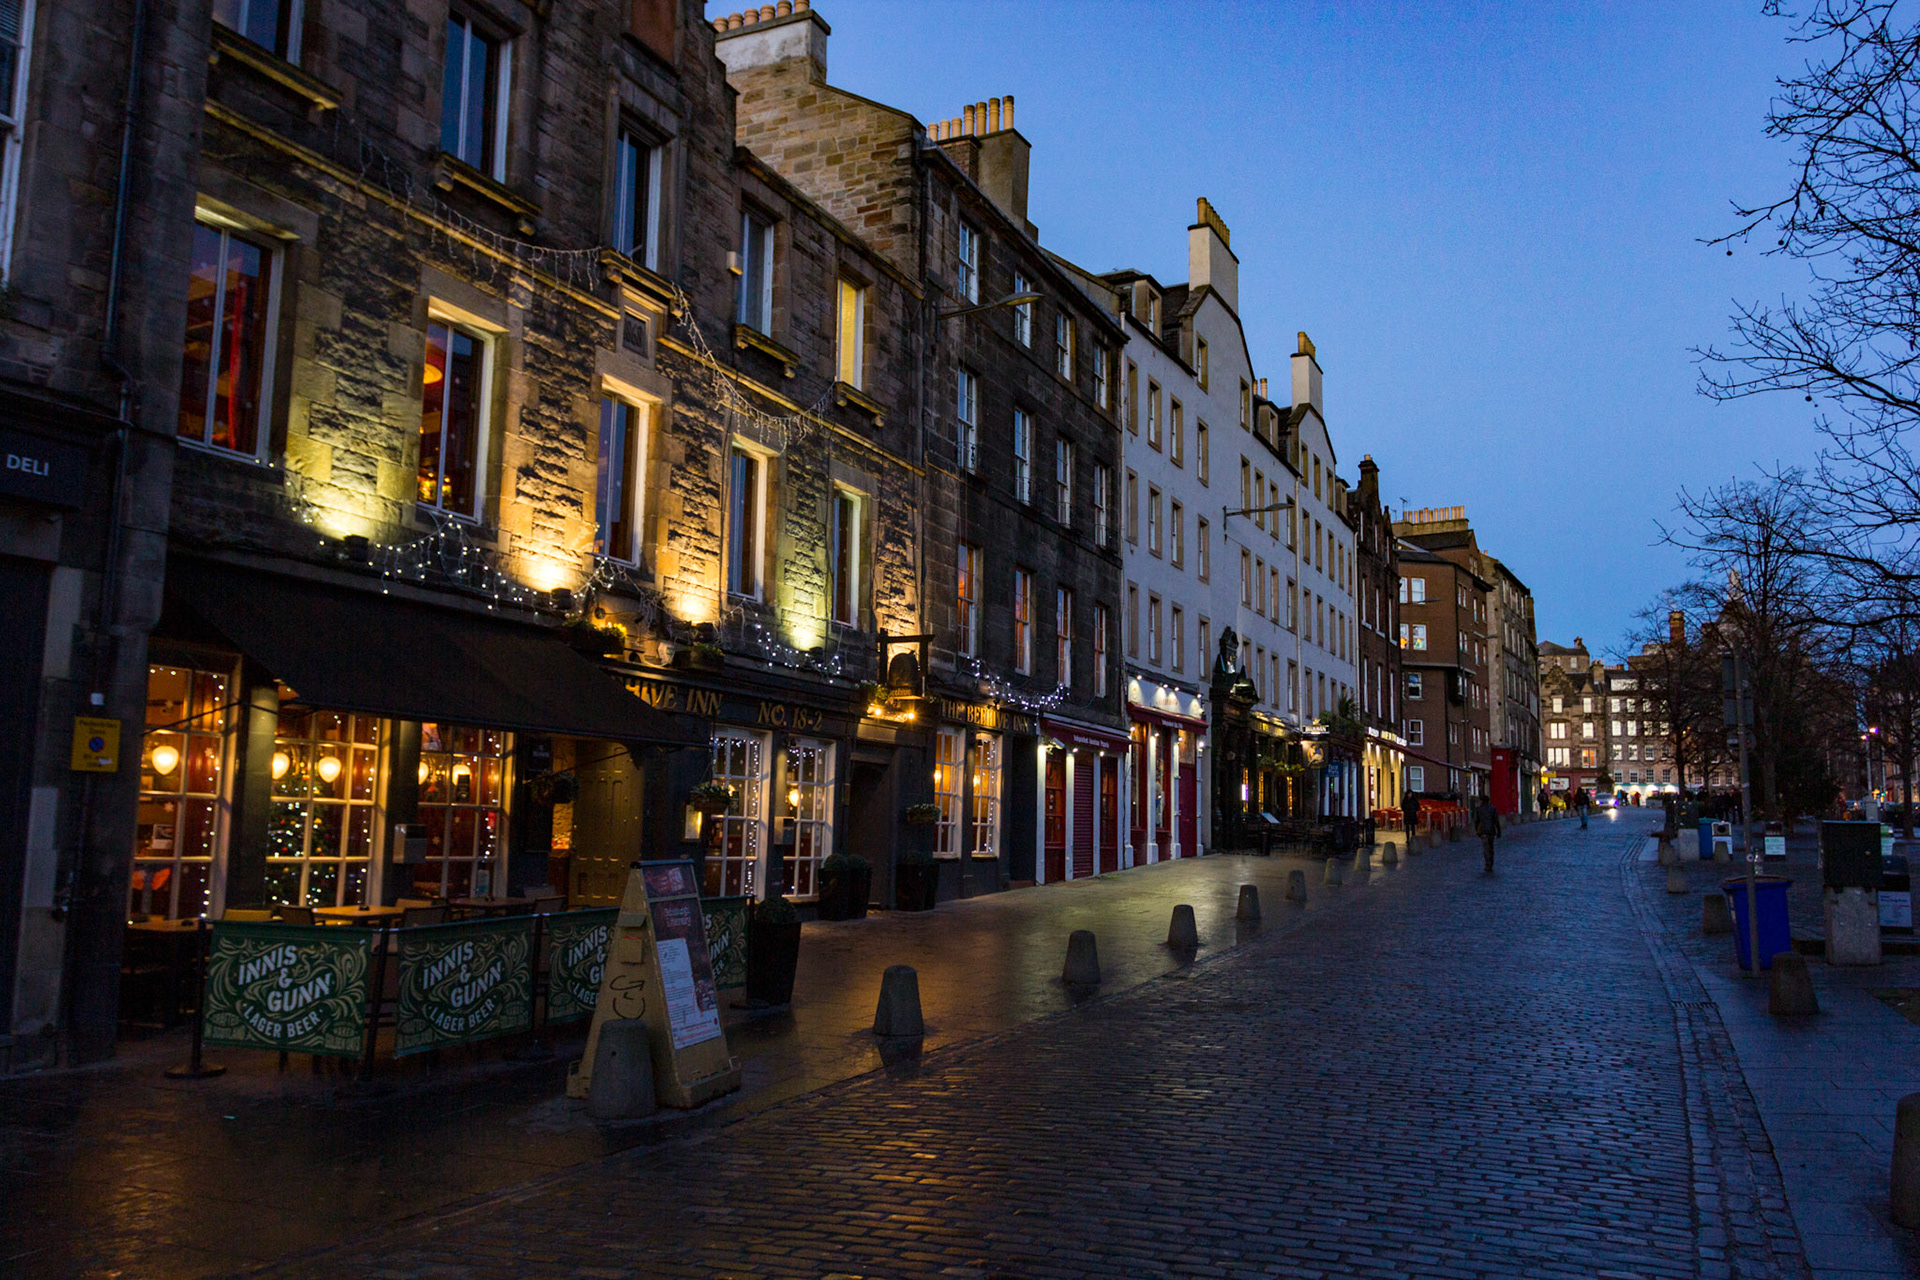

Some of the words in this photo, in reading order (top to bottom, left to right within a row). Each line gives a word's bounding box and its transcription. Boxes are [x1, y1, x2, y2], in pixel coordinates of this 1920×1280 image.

[6, 453, 49, 477] DELI
[686, 686, 724, 716] INN
[757, 701, 788, 727] NO.
[567, 925, 608, 968] INNIS
[596, 944, 607, 964] &
[237, 945, 297, 986] INNIS
[278, 967, 294, 989] &
[422, 941, 474, 990] INNIS
[459, 963, 472, 984] &
[266, 972, 333, 1013] GUNN
[450, 960, 504, 1008] GUNN
[243, 1004, 283, 1039] LAGER
[286, 1010, 322, 1039] BEER
[429, 1006, 466, 1032] LAGER
[468, 998, 496, 1029] BEER
